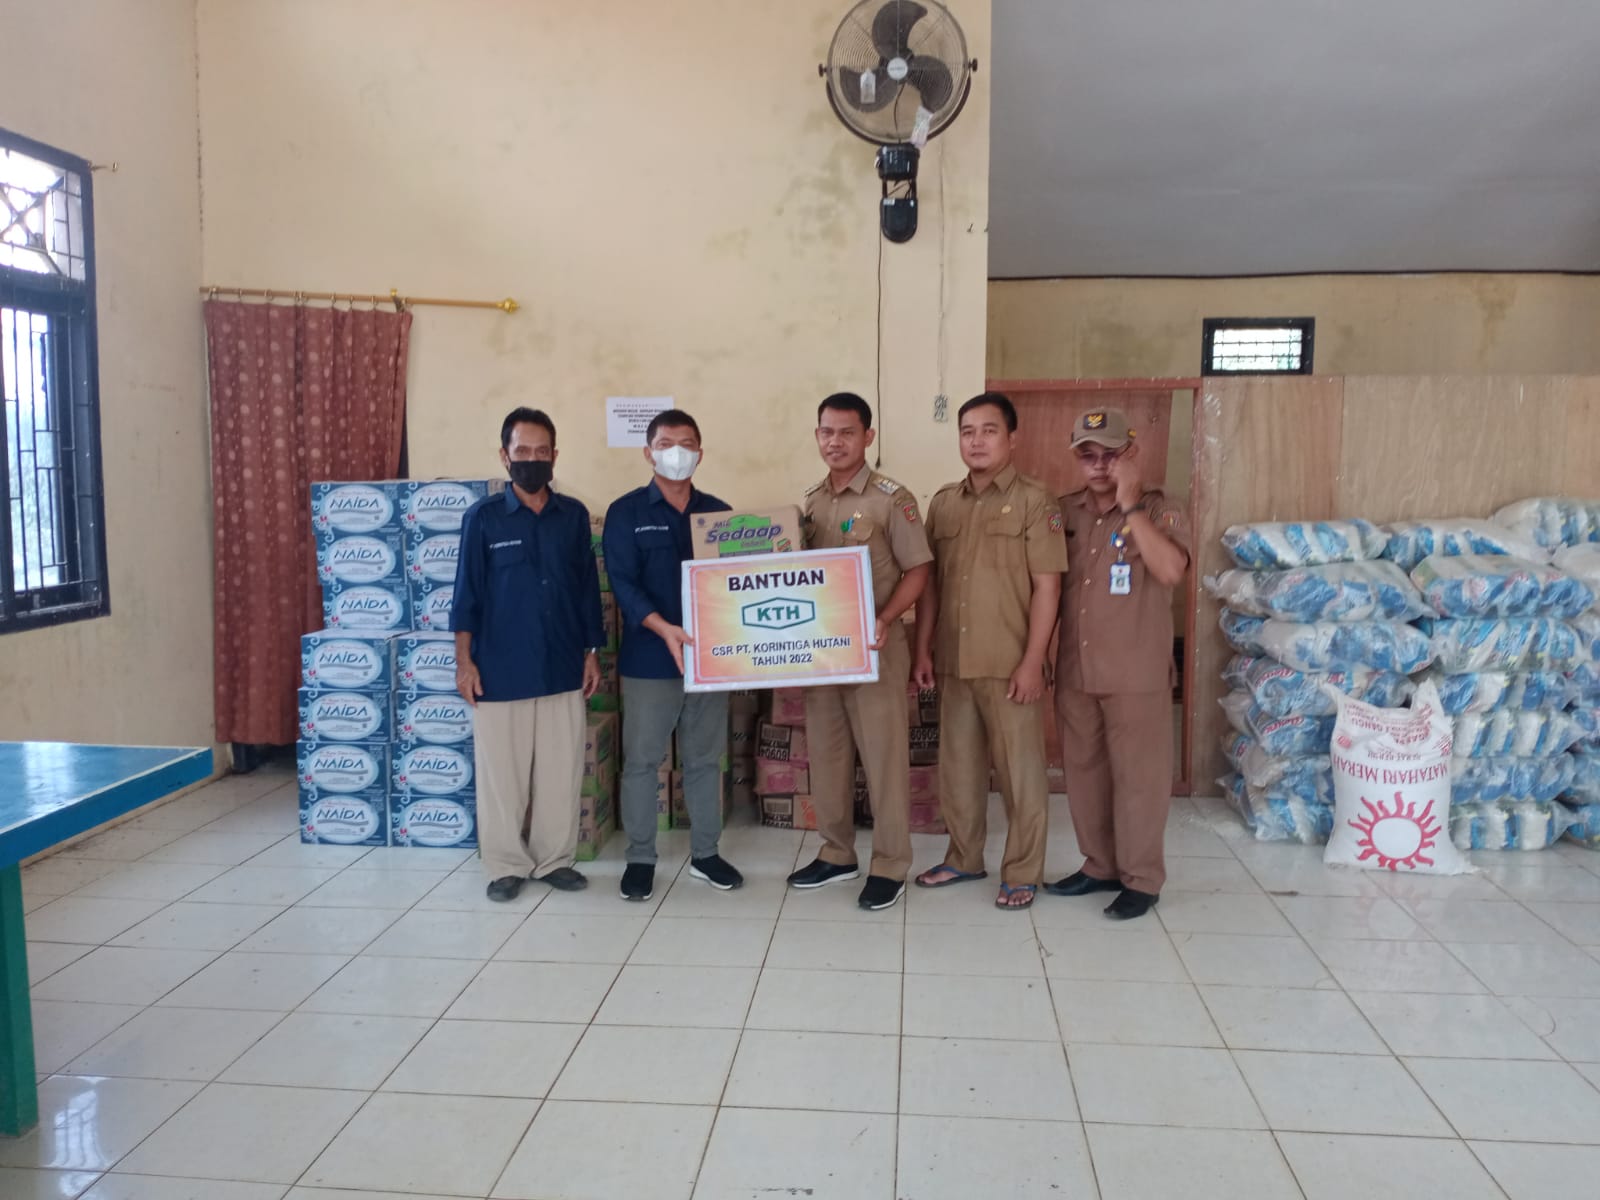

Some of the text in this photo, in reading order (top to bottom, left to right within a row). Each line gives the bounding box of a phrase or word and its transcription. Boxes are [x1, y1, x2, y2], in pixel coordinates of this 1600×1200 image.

[706, 525, 782, 544] Sedaap
[728, 570, 824, 591] BANTUAN
[757, 605, 800, 621] KTH
[712, 637, 850, 656] CSR PT. KORINTIGA HUTANI
[752, 653, 812, 666] TAHUN 2022
[1383, 762, 1448, 784] MATAHARI
